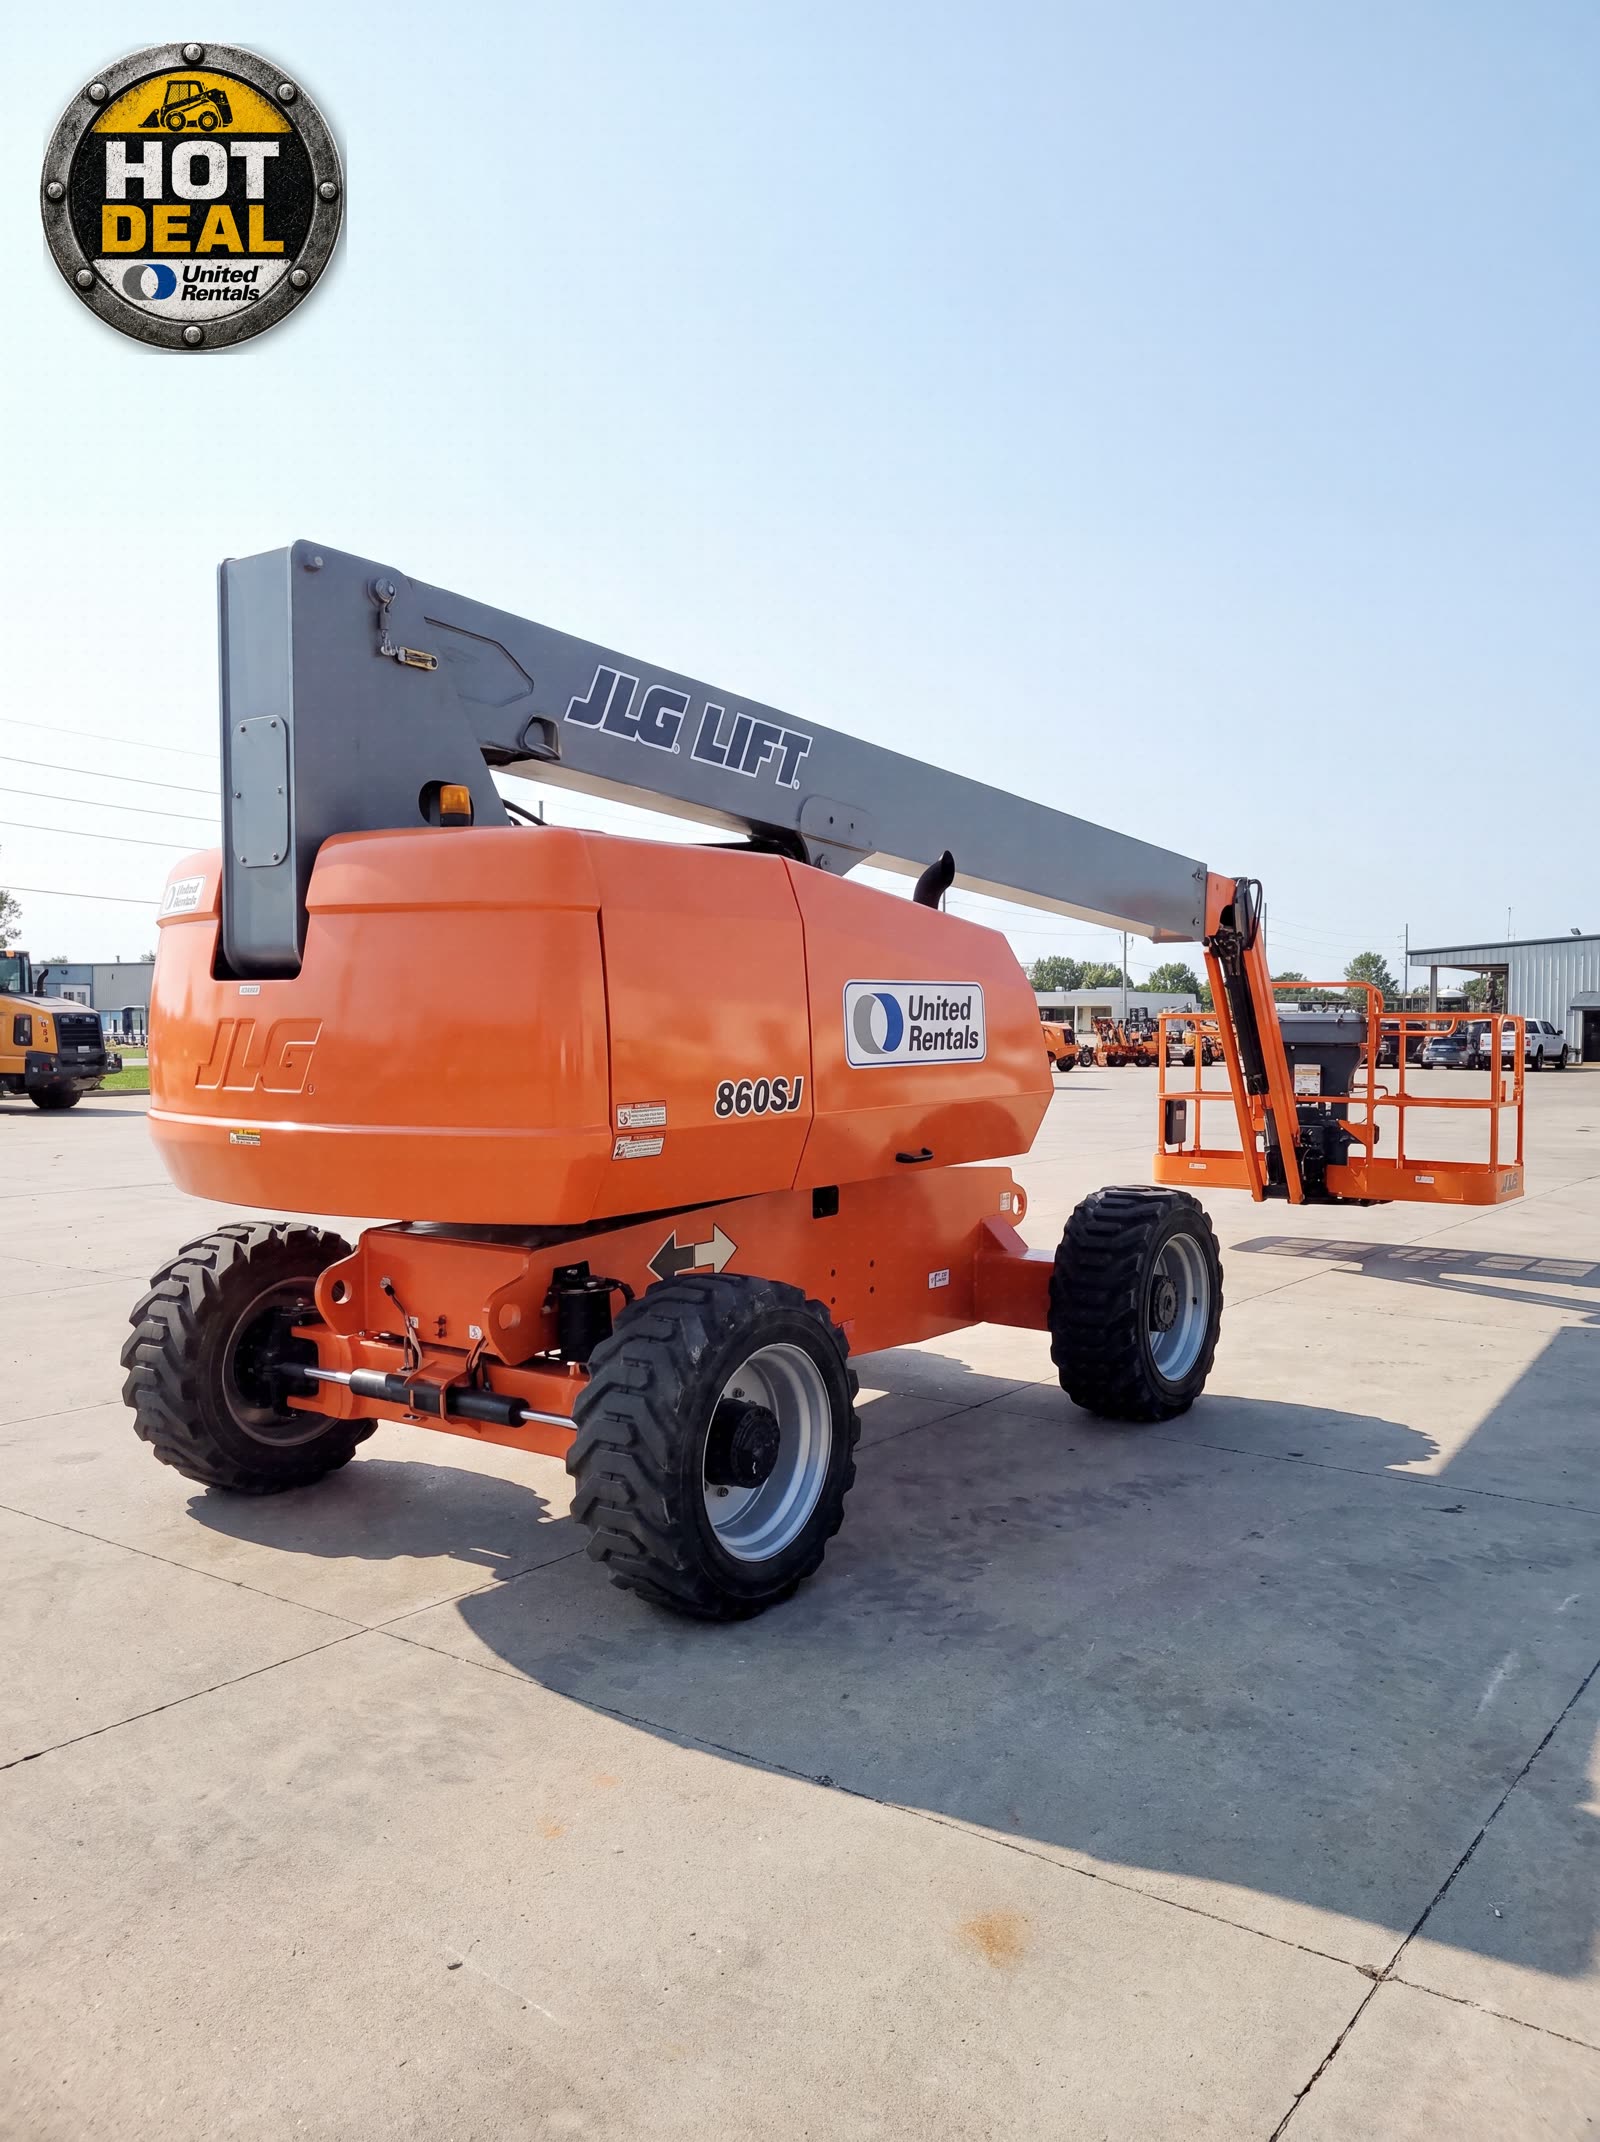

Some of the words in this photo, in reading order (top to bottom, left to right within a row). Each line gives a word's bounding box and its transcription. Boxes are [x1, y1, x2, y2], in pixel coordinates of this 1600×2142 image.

[564, 665, 691, 753] JLG
[690, 702, 813, 788] LIFT
[908, 995, 972, 1021] United
[195, 1018, 323, 1094] JLG
[908, 1025, 979, 1051] Rentals
[715, 1077, 803, 1117] 860SJ
